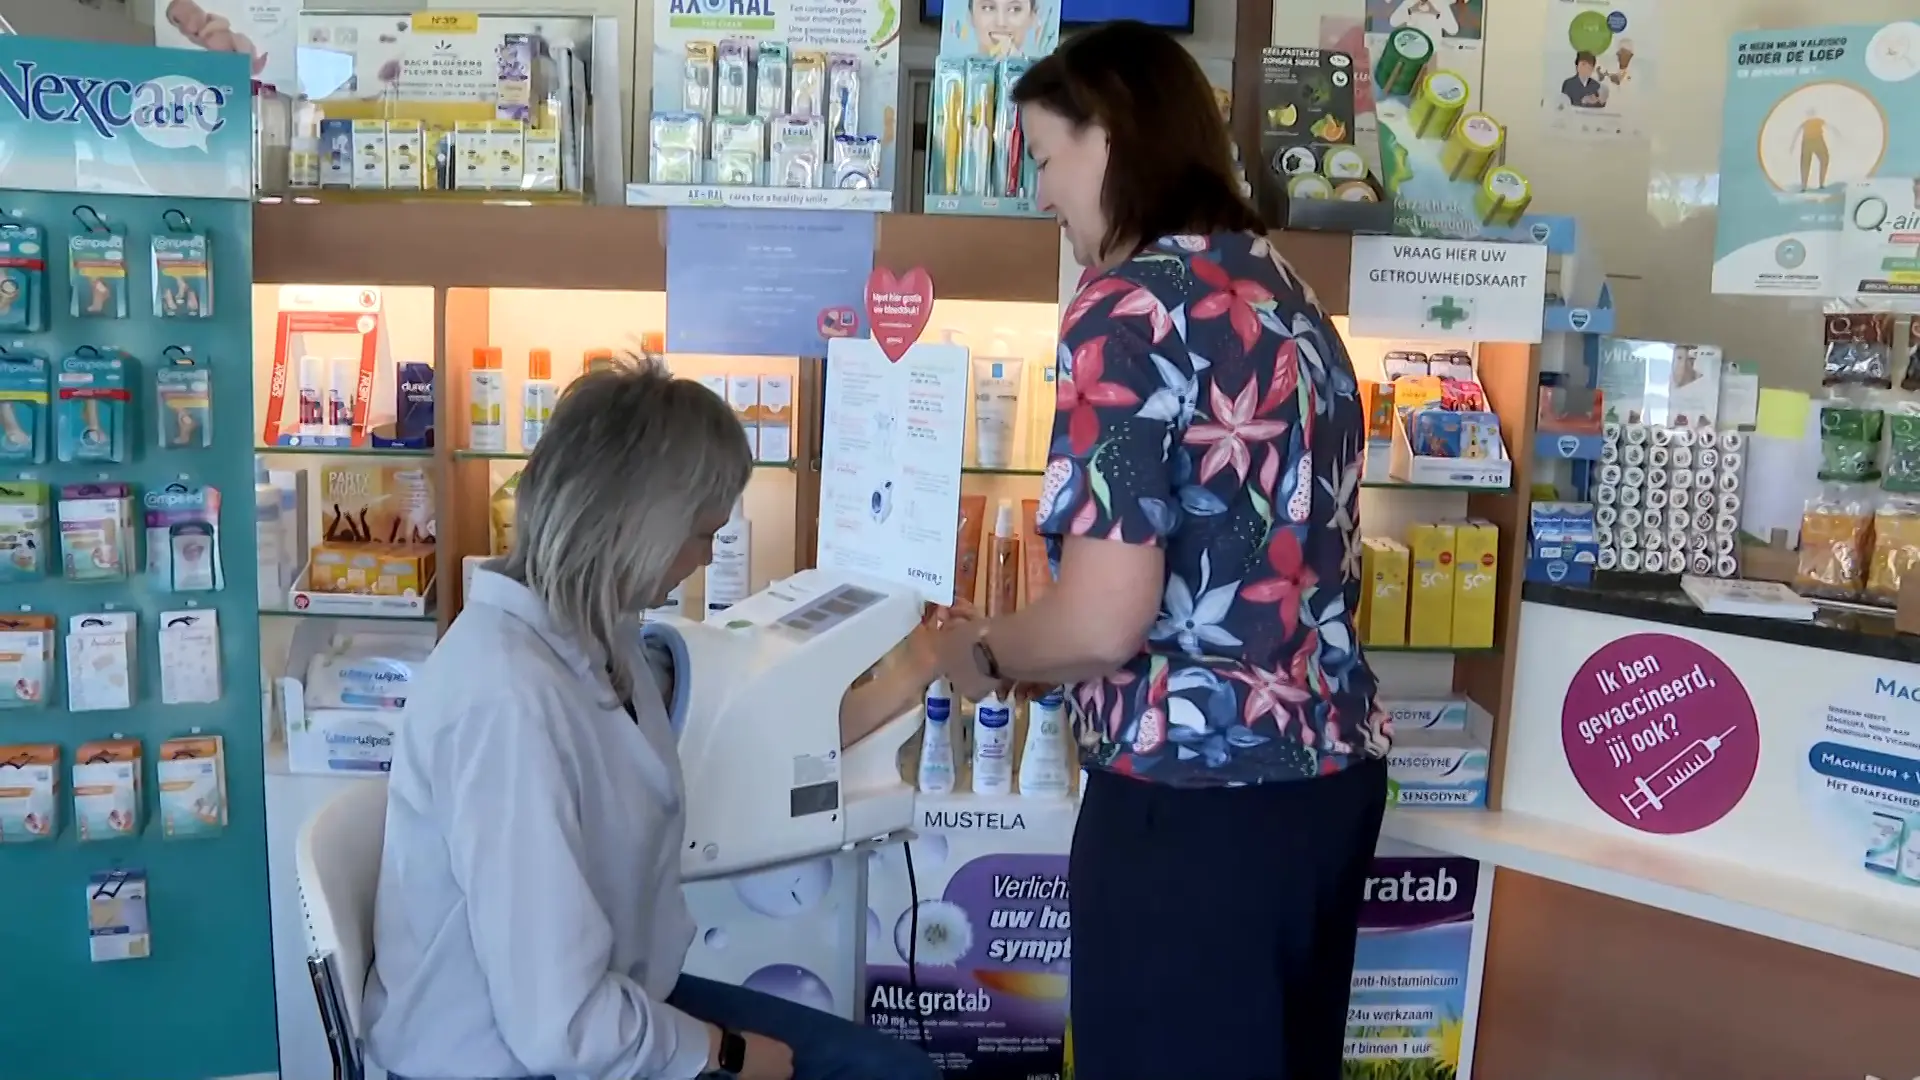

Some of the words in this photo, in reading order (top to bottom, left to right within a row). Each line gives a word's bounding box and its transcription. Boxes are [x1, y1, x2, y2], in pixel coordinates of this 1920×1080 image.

[1738, 51, 1782, 66] ONDER
[1786, 50, 1805, 64] DE
[1809, 47, 1845, 62] LOEP
[0, 61, 225, 138] Nexcare
[752, 191, 764, 201] for
[1393, 245, 1441, 260] VRAAG
[1445, 248, 1477, 262] HIER
[1481, 250, 1507, 262] UW
[1369, 269, 1527, 288] GETROUWHEIDSKAART
[401, 380, 432, 392] durex
[907, 567, 937, 582] SERVIER
[1595, 669, 1621, 696] Ik
[1618, 654, 1661, 685] ben
[1578, 663, 1716, 744] gevaccineerd,
[1605, 735, 1633, 768] jij
[1631, 713, 1680, 752] ook?
[1402, 790, 1468, 802] SENSODYNE
[925, 811, 1026, 830] MUSTELA
[994, 874, 1069, 899] Verlich
[1363, 867, 1458, 902] ratab
[990, 910, 1035, 929] uw
[1039, 904, 1071, 929] ho
[988, 936, 1071, 964] sympt
[1352, 975, 1459, 988] anti-histaminicum
[871, 985, 991, 1016] Allegratab
[871, 1013, 888, 1026] 120
[1373, 1008, 1433, 1021] werkzaam
[1358, 1042, 1398, 1054] binnen
[1411, 1043, 1431, 1054] uur
